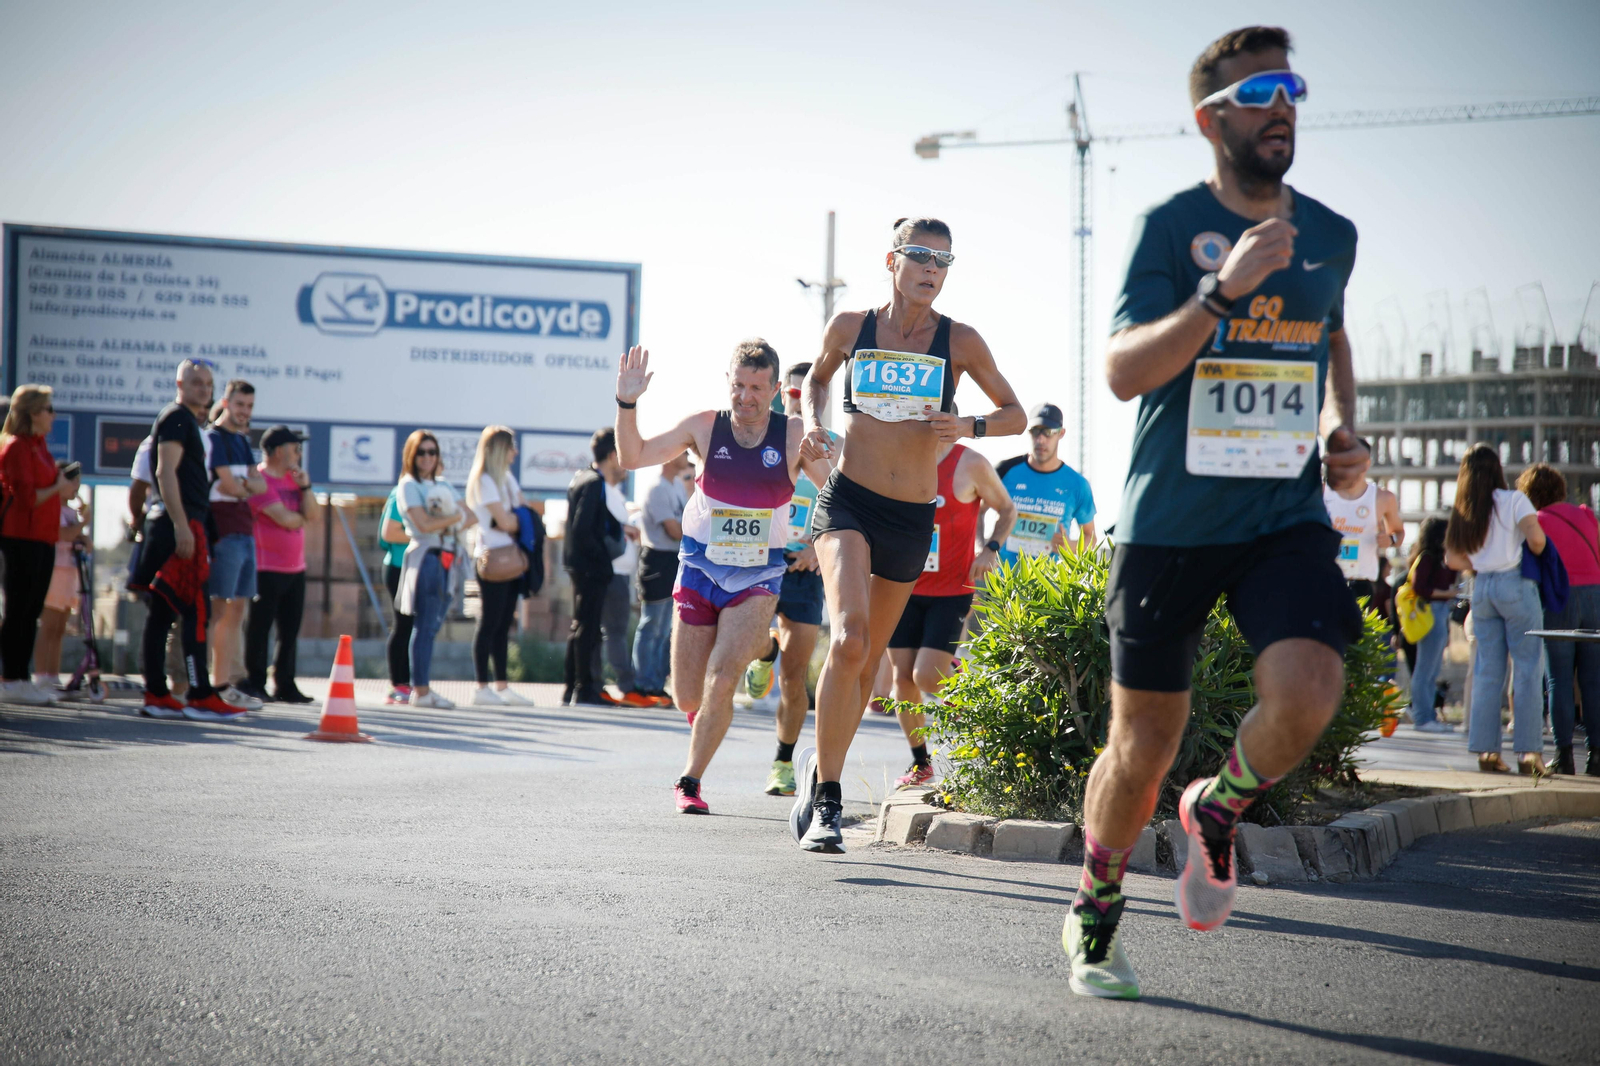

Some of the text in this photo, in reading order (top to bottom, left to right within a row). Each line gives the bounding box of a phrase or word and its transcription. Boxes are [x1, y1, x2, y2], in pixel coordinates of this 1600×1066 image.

[97, 269, 115, 282] de
[394, 292, 603, 337] Prodicoyde
[1226, 318, 1323, 344] TRAINING
[101, 337, 166, 353] ALHAMA
[172, 341, 193, 354] DE
[410, 346, 610, 370] DISTRIBUIDOR OFICIAL
[864, 361, 935, 386] 1637
[1207, 380, 1304, 416] 1014
[722, 518, 760, 536] 486
[1020, 519, 1047, 536] 102
